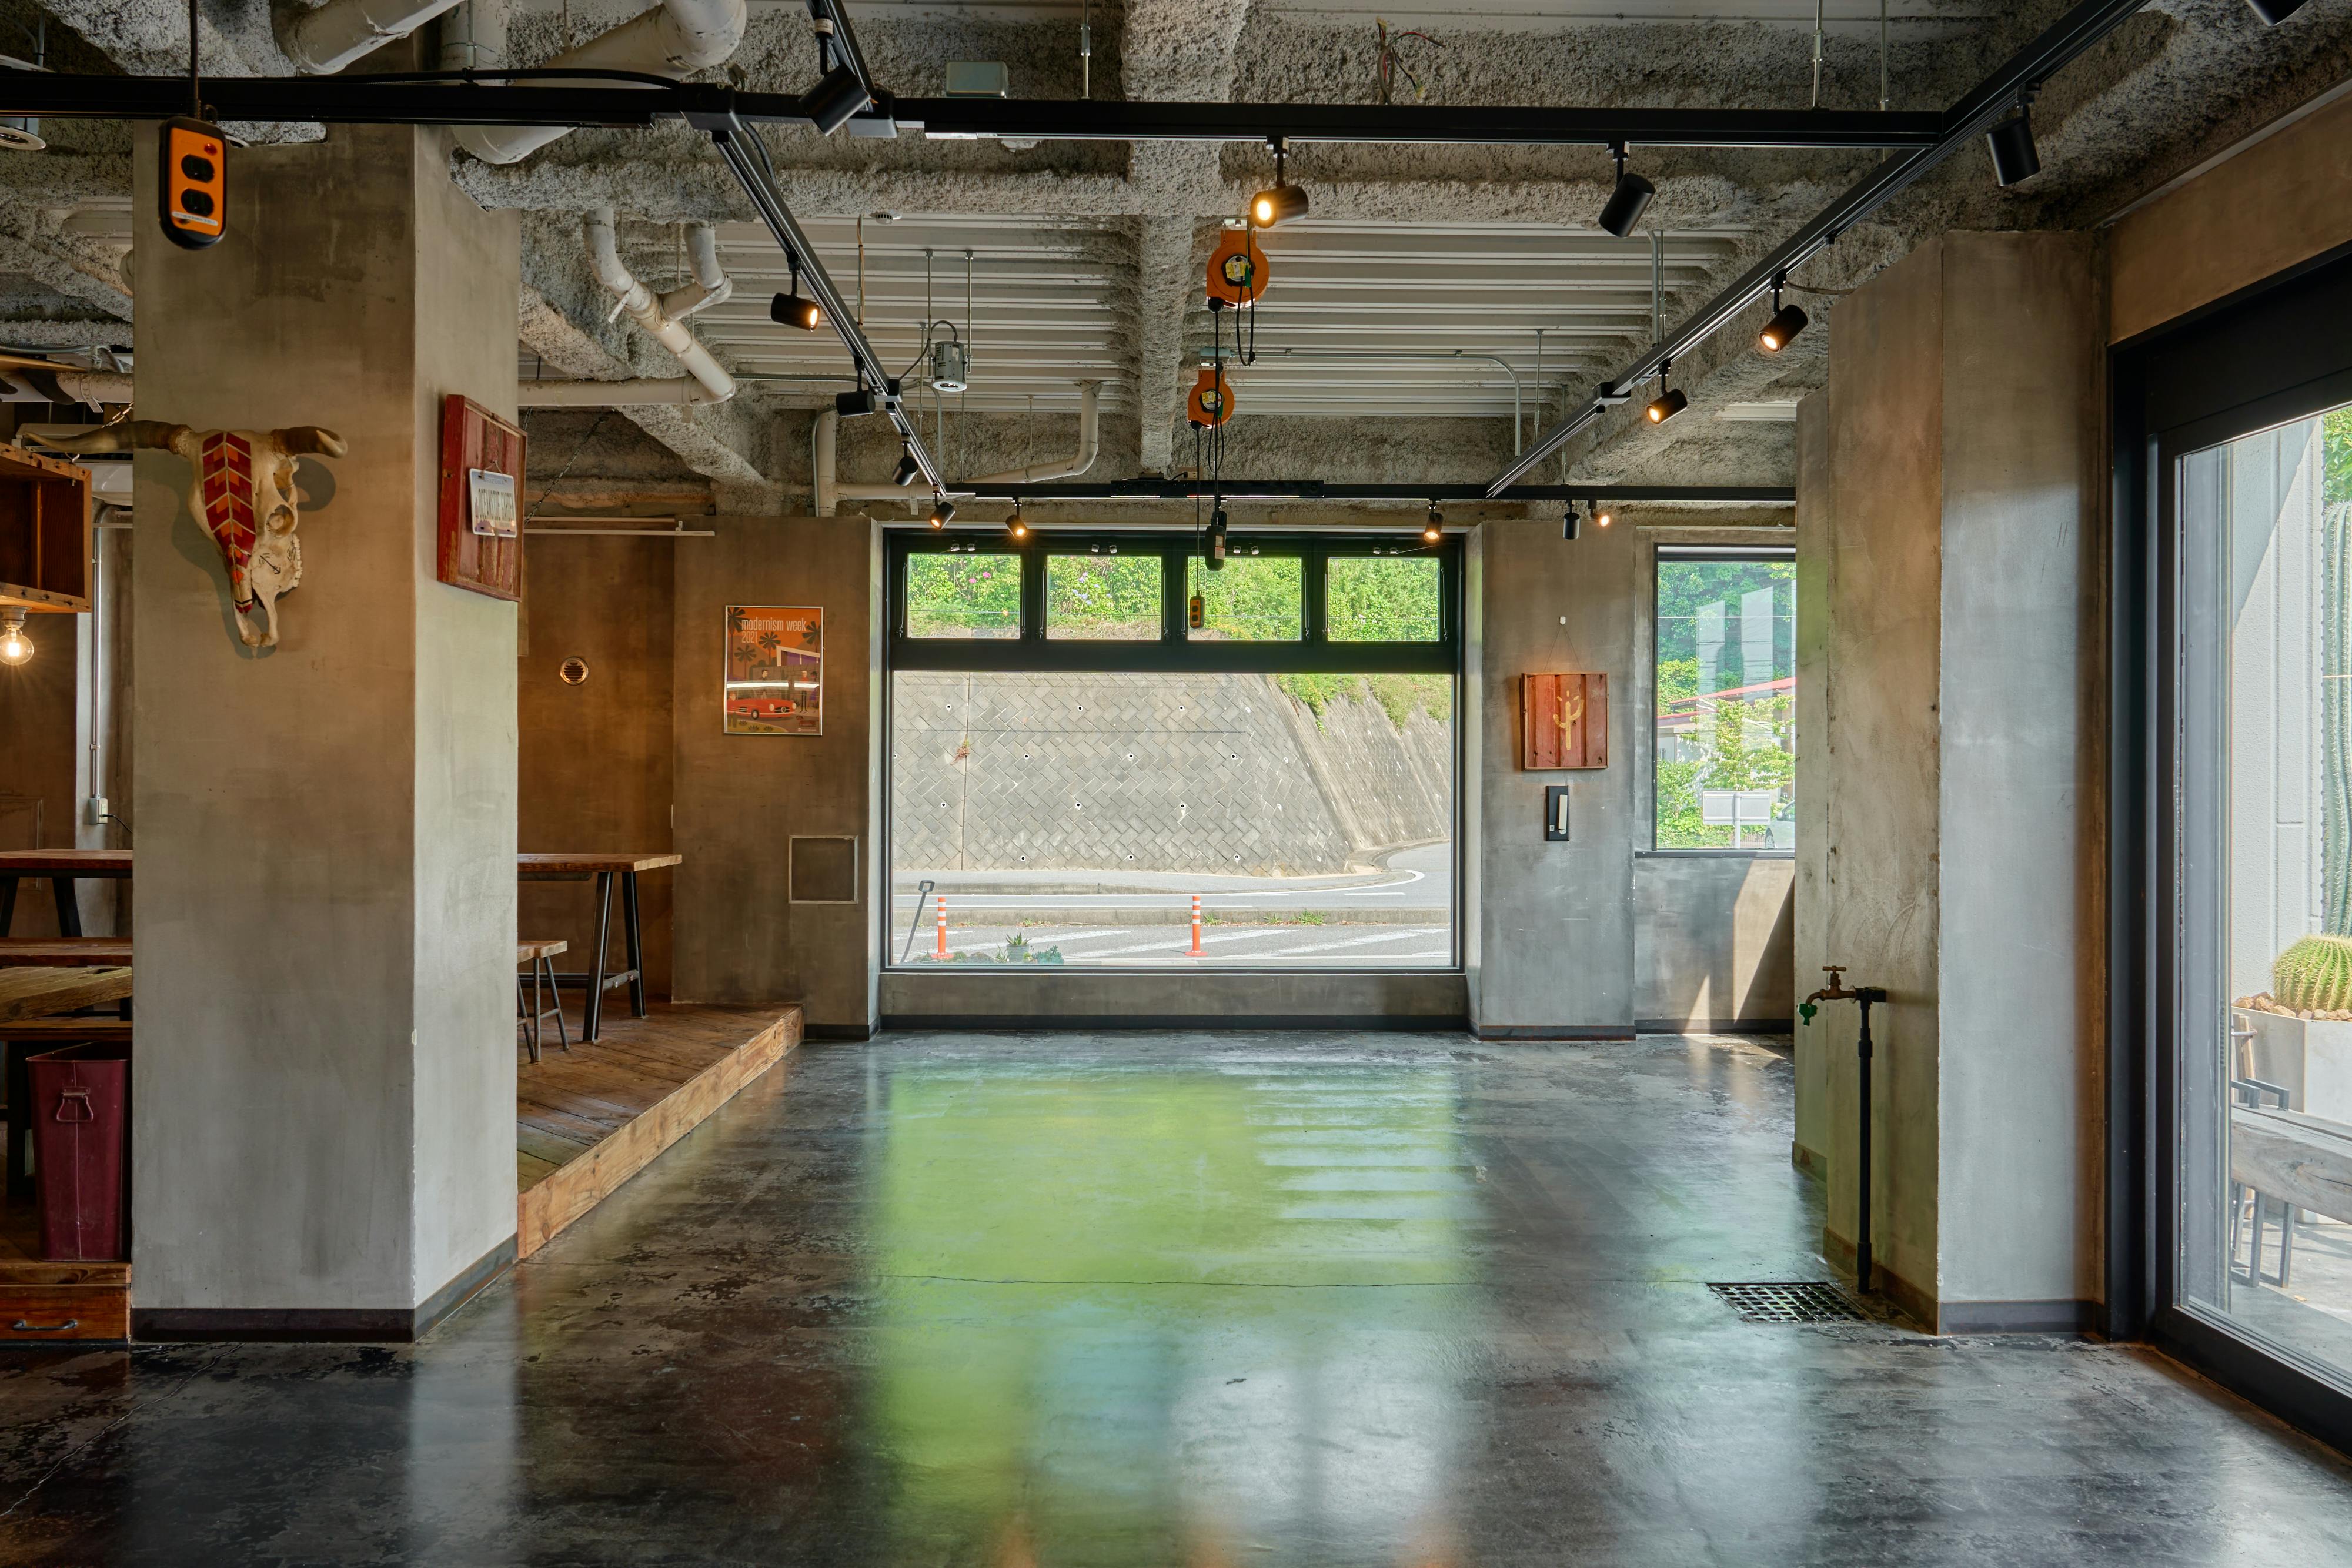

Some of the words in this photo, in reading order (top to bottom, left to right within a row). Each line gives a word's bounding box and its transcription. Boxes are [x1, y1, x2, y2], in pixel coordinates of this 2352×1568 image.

[742, 617, 784, 631] modernism
[787, 618, 806, 631] week
[742, 631, 757, 643] 2021
